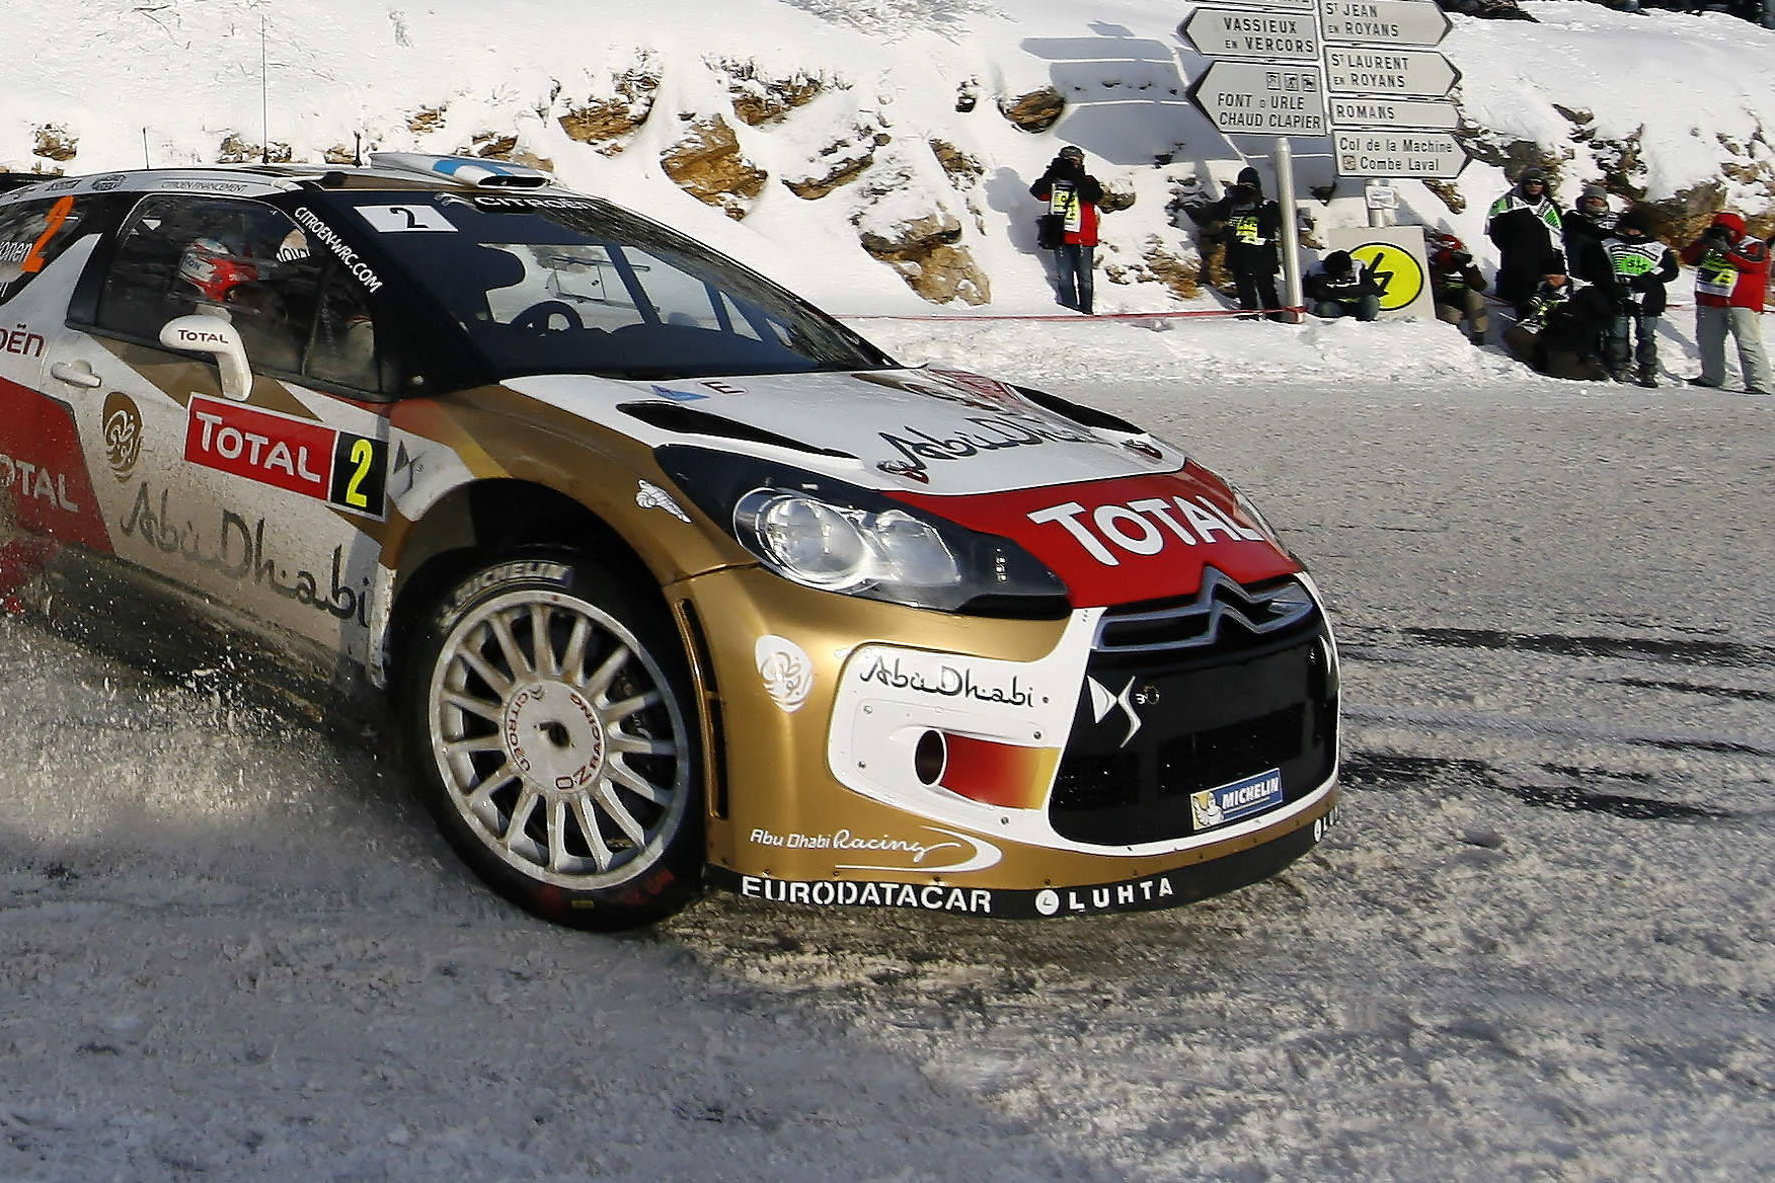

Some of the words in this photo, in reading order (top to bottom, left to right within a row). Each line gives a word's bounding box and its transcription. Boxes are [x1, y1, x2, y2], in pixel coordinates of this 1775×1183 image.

[1343, 4, 1378, 18] JEAN
[1223, 17, 1297, 34] VASSIEUX
[1329, 24, 1339, 34] EN
[1345, 21, 1398, 37] ROYANS
[1225, 39, 1238, 49] EN
[1245, 36, 1314, 53] VERCORS
[1348, 54, 1409, 70] LAURENT
[1333, 76, 1345, 85] EN
[1351, 73, 1405, 88] ROYANS
[1218, 93, 1253, 107] FONT
[1219, 112, 1263, 127] CHAUD
[1269, 114, 1320, 129] CLAPIER
[1336, 104, 1395, 119] ROMANS
[1340, 137, 1360, 151] Col
[1366, 138, 1380, 152] de
[1386, 139, 1397, 152] la
[1403, 139, 1453, 153] Machine
[1360, 156, 1402, 170] Combe
[1408, 158, 1439, 171] Laval
[389, 207, 430, 229] 2
[21, 195, 76, 273] 2
[294, 206, 383, 293] CITROEN-WRC.COM
[177, 328, 230, 345] TOTAL
[195, 411, 322, 484] TOTAL
[345, 438, 374, 508] 2
[1026, 495, 1266, 566] TOTAL
[120, 481, 221, 564] Abu
[221, 509, 371, 629] Dhabi
[859, 656, 937, 692] Abu
[938, 665, 1034, 707] Dhabi
[1222, 777, 1279, 809] MICHELIN
[749, 829, 784, 847] Abu
[786, 833, 830, 850] Dhabi
[833, 829, 947, 863] Racing
[741, 875, 992, 914] EURODATACAR
[1068, 877, 1173, 912] LUHTA
